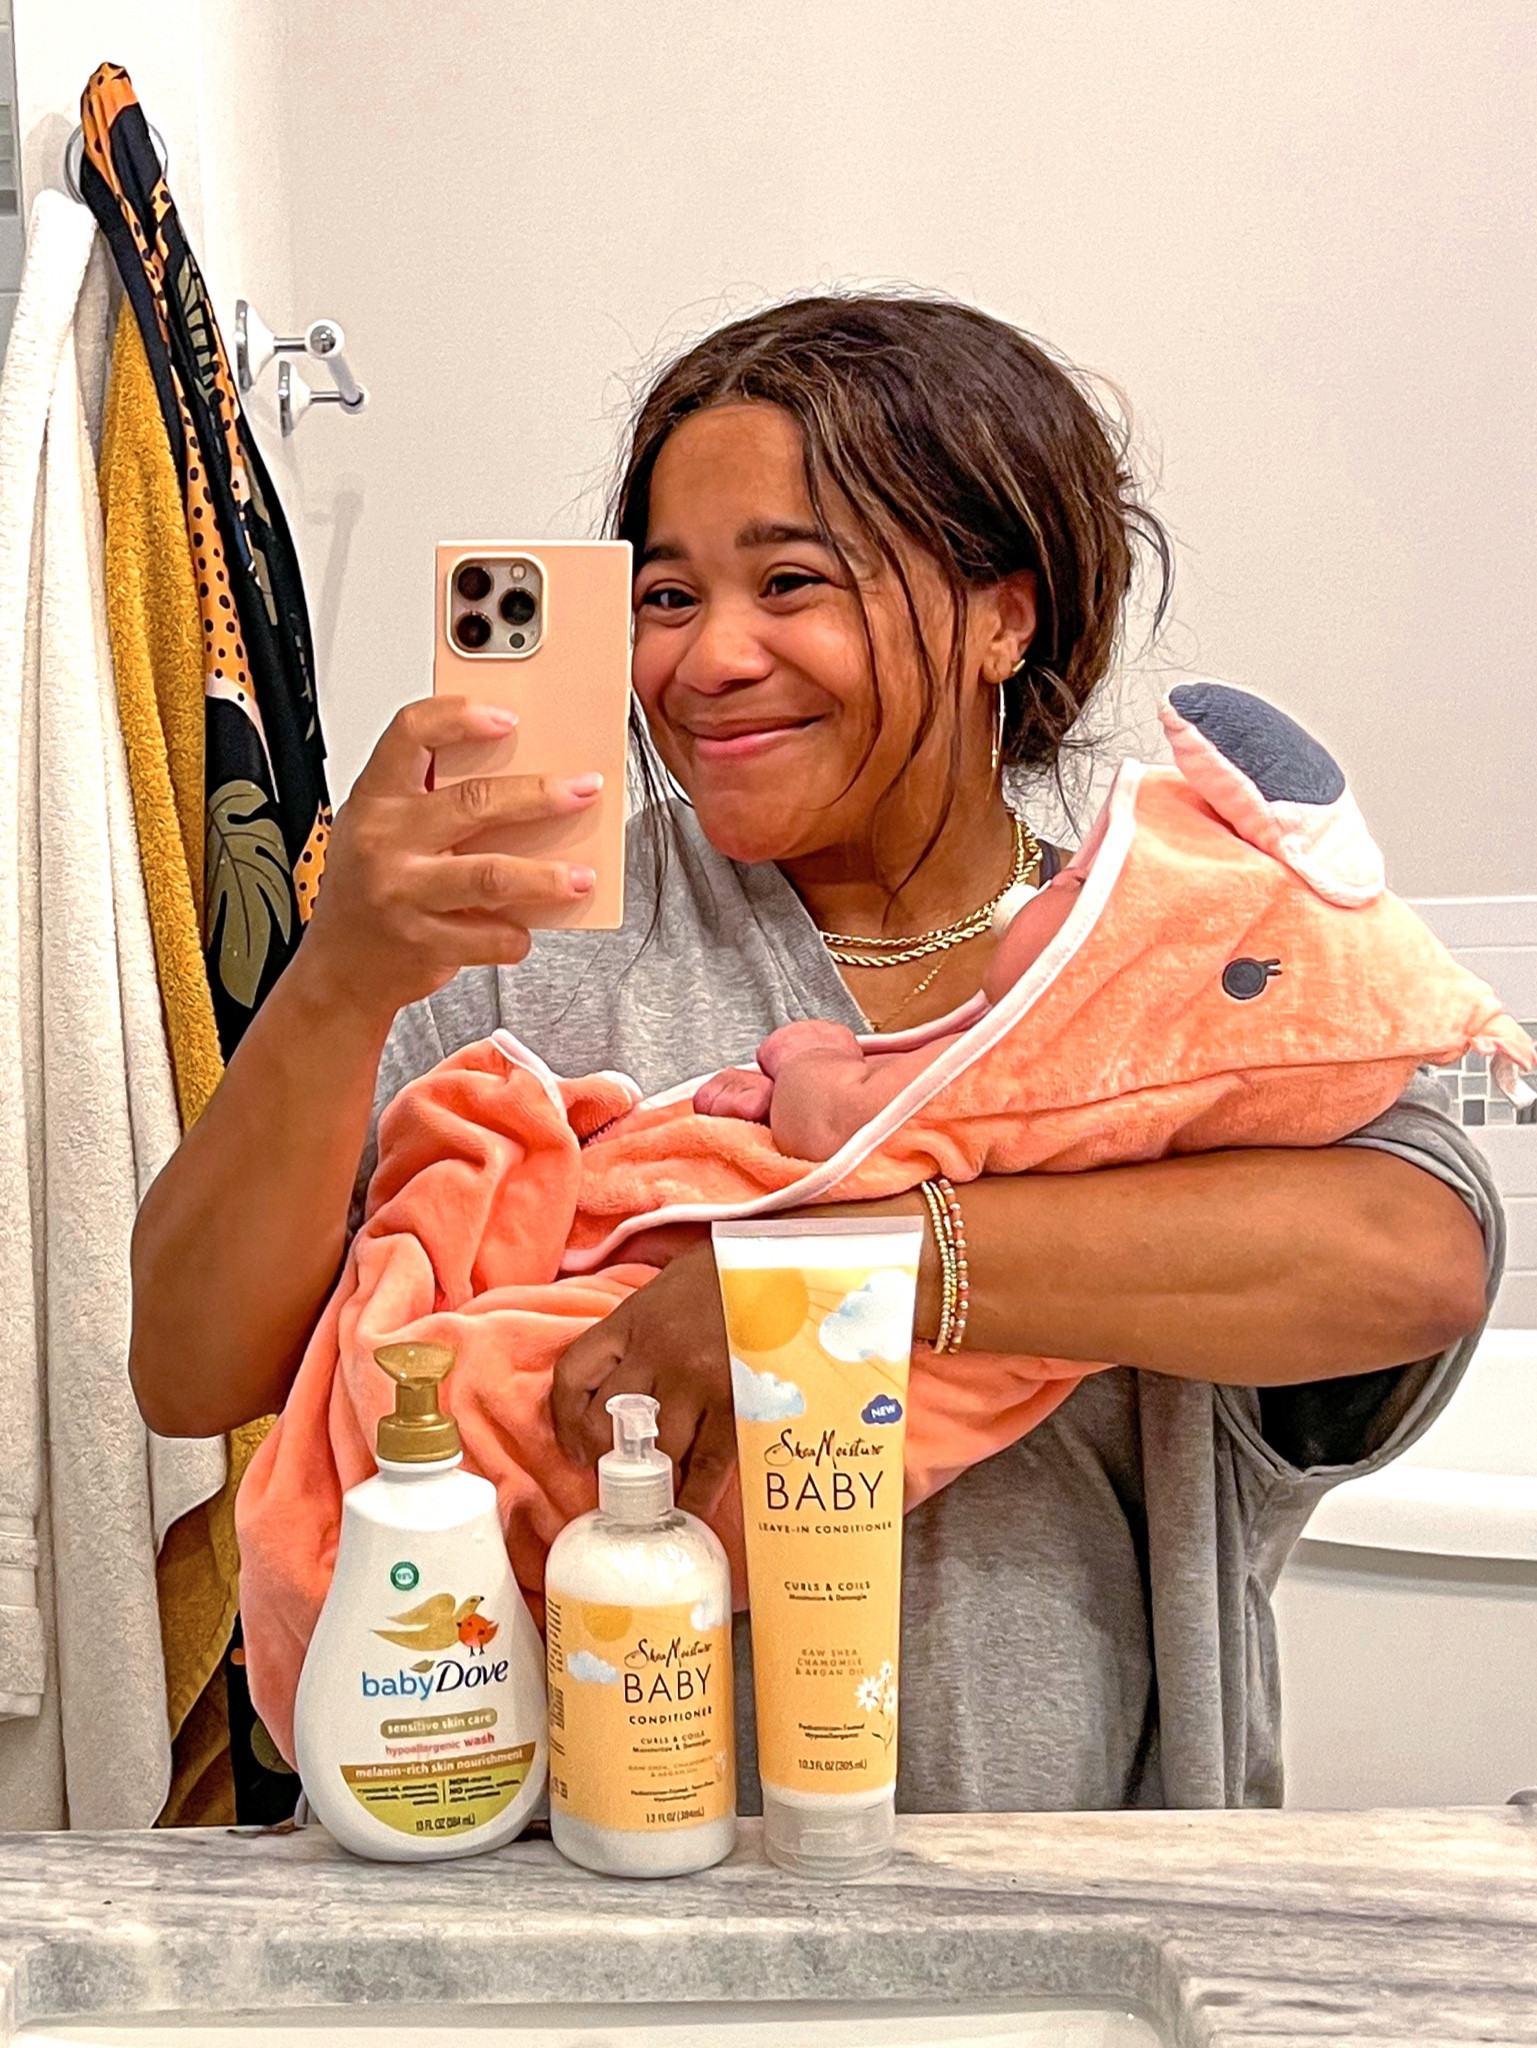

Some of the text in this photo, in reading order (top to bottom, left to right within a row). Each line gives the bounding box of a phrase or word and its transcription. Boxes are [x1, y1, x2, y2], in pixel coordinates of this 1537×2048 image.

[871, 1404, 896, 1418] NEW
[766, 1470, 883, 1512] BABY
[759, 1521, 892, 1534] LEAVE-IN CONDITIONER
[784, 1581, 870, 1591] CURLS & COILS
[797, 1658, 862, 1667] CHAMOMILE
[806, 1668, 843, 1676] ARGAN
[624, 1663, 711, 1703] BABY
[629, 1705, 712, 1724] CONDITIONER
[387, 1713, 493, 1734] sensitive skin care
[385, 1732, 495, 1758] hypoallergenic wash
[355, 1749, 523, 1778] melanin-rich skin nourishment
[646, 1813, 656, 1823] 13
